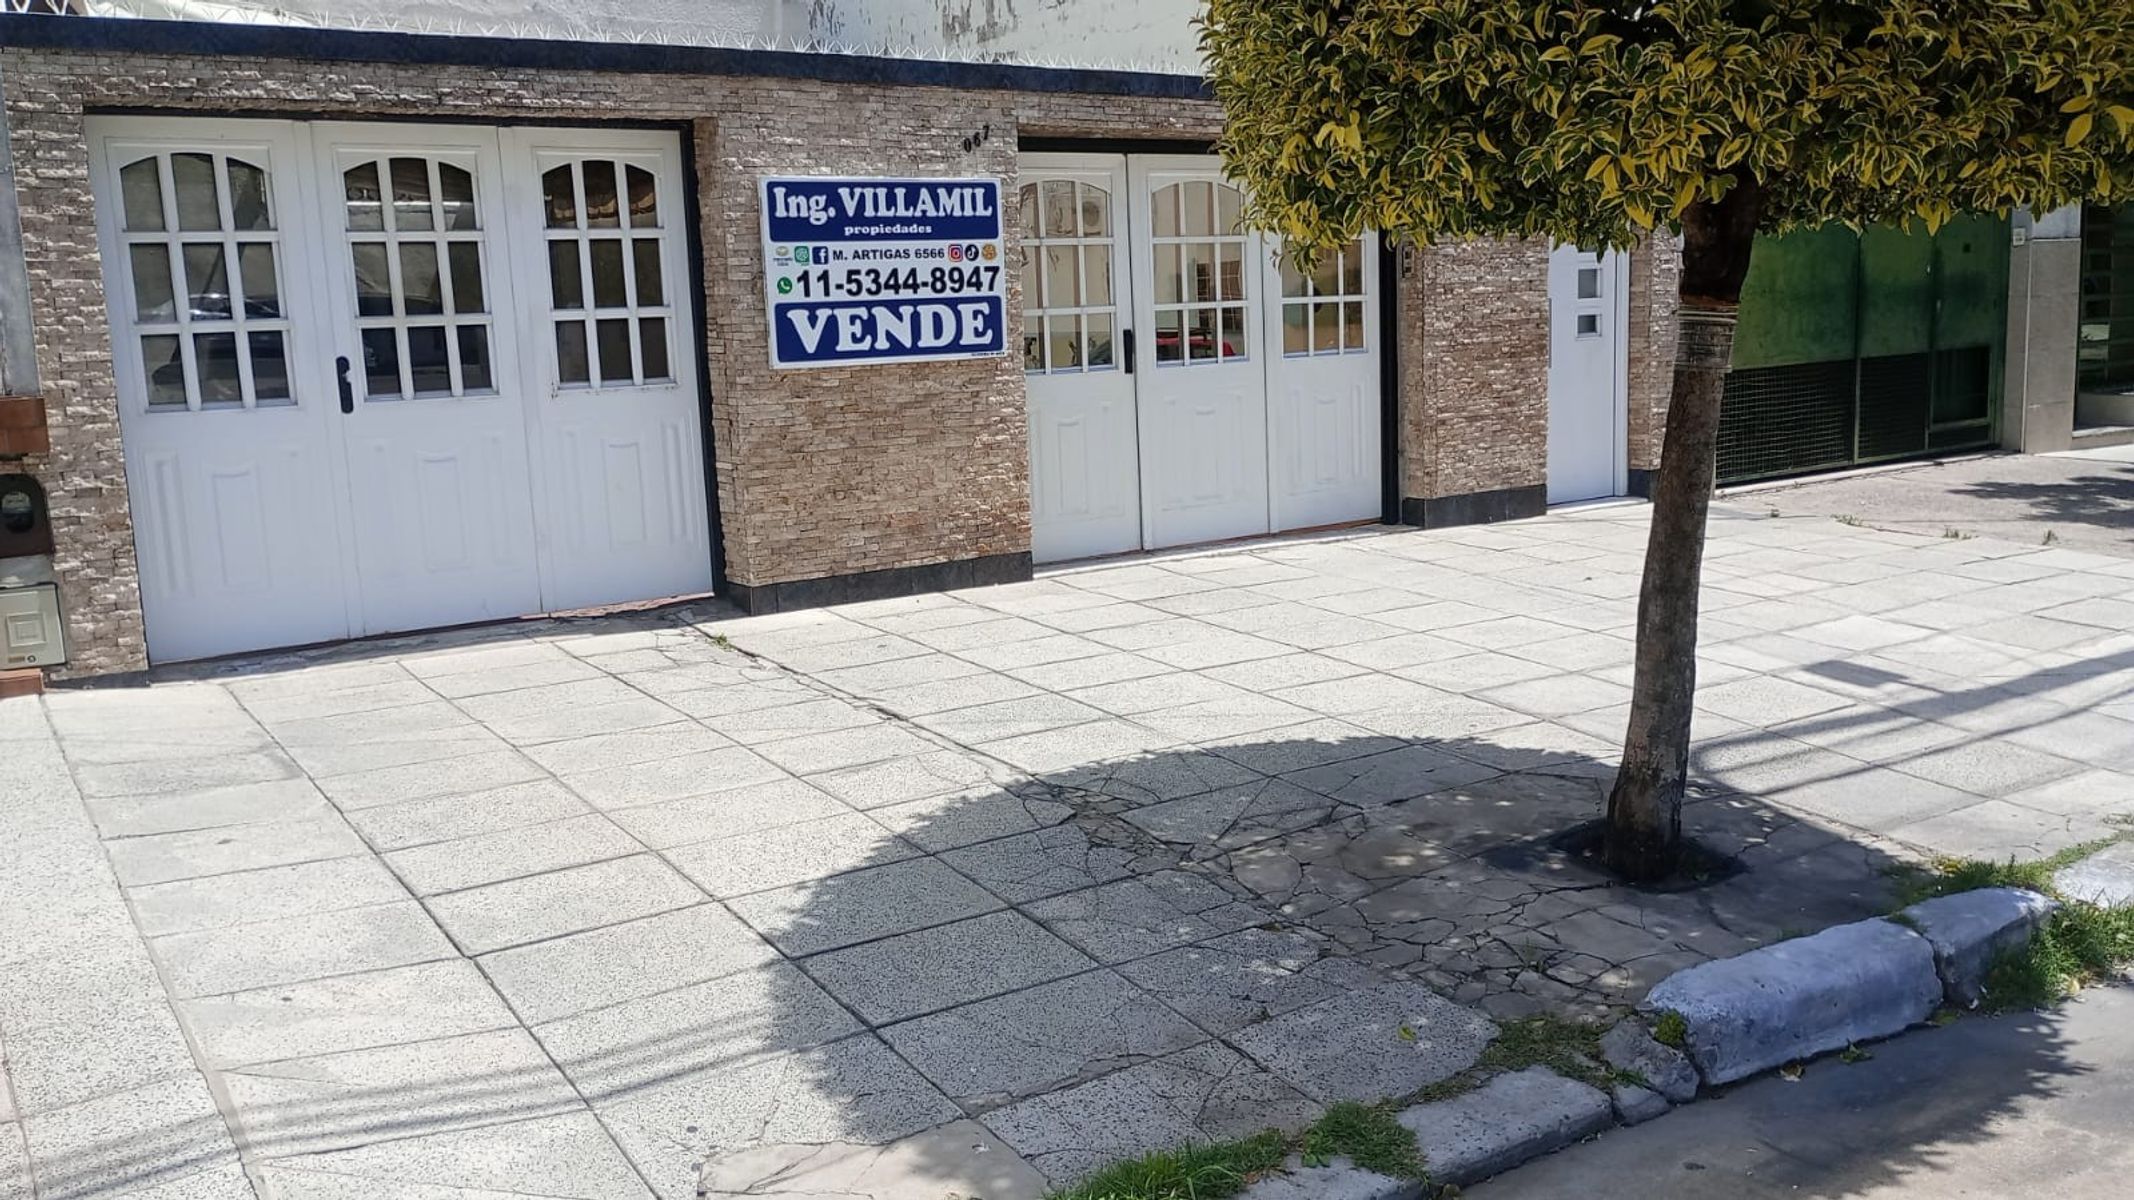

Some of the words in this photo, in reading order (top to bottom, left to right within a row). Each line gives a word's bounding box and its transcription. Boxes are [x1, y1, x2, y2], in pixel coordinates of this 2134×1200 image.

[773, 187, 836, 225] Ing.
[838, 187, 993, 217] VILLAMIL
[844, 223, 932, 236] propiedades
[832, 250, 848, 261] M.
[852, 249, 911, 260] ARTIGAS
[914, 248, 945, 260] 6566
[797, 265, 1000, 298] 11-5344-8947
[787, 302, 993, 354] VENDE
